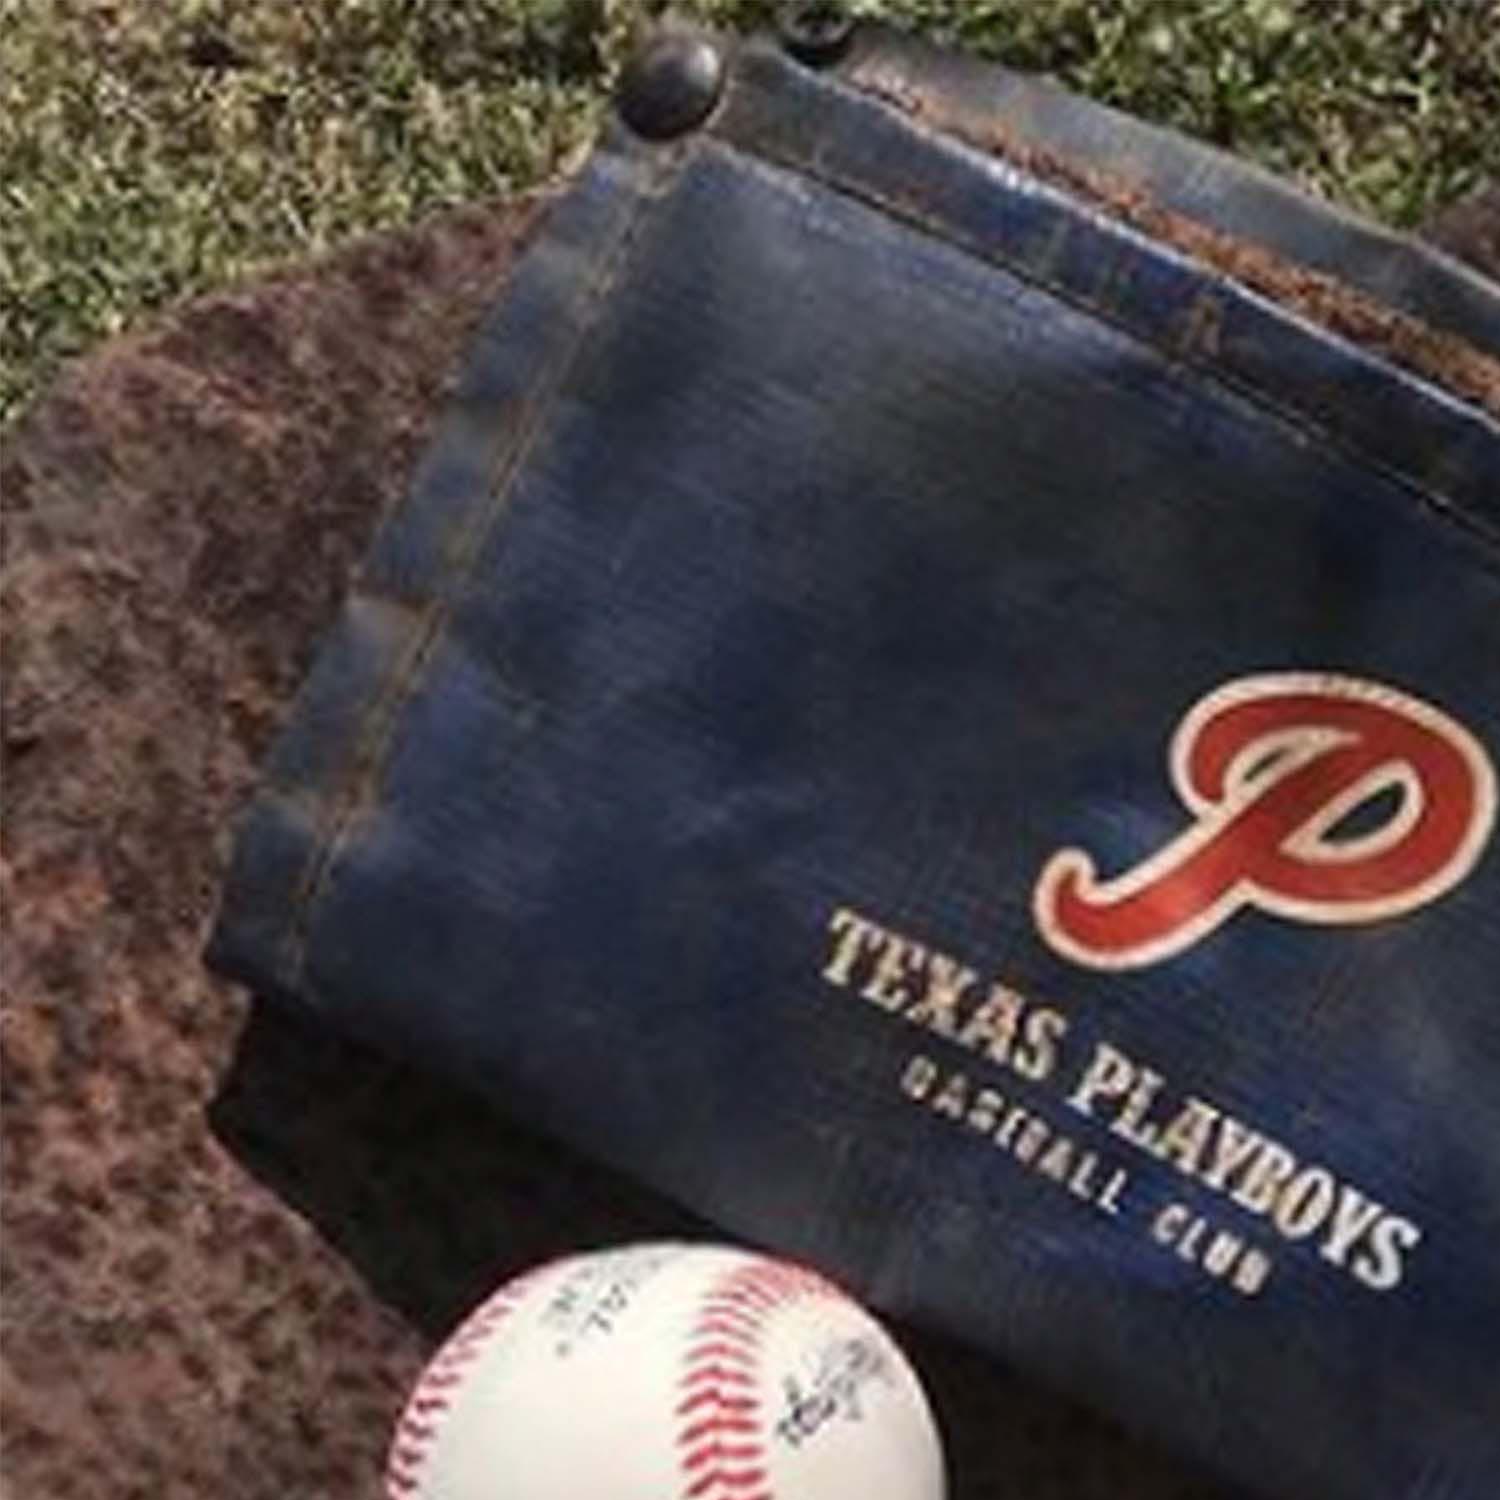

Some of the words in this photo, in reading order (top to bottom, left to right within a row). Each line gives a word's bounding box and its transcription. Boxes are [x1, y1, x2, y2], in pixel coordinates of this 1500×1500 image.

[1035, 672, 1497, 970] P
[822, 909, 1067, 1081] TEXAS
[1068, 1043, 1421, 1289] PLAYBOYS
[1153, 1204, 1273, 1296] CLUB
